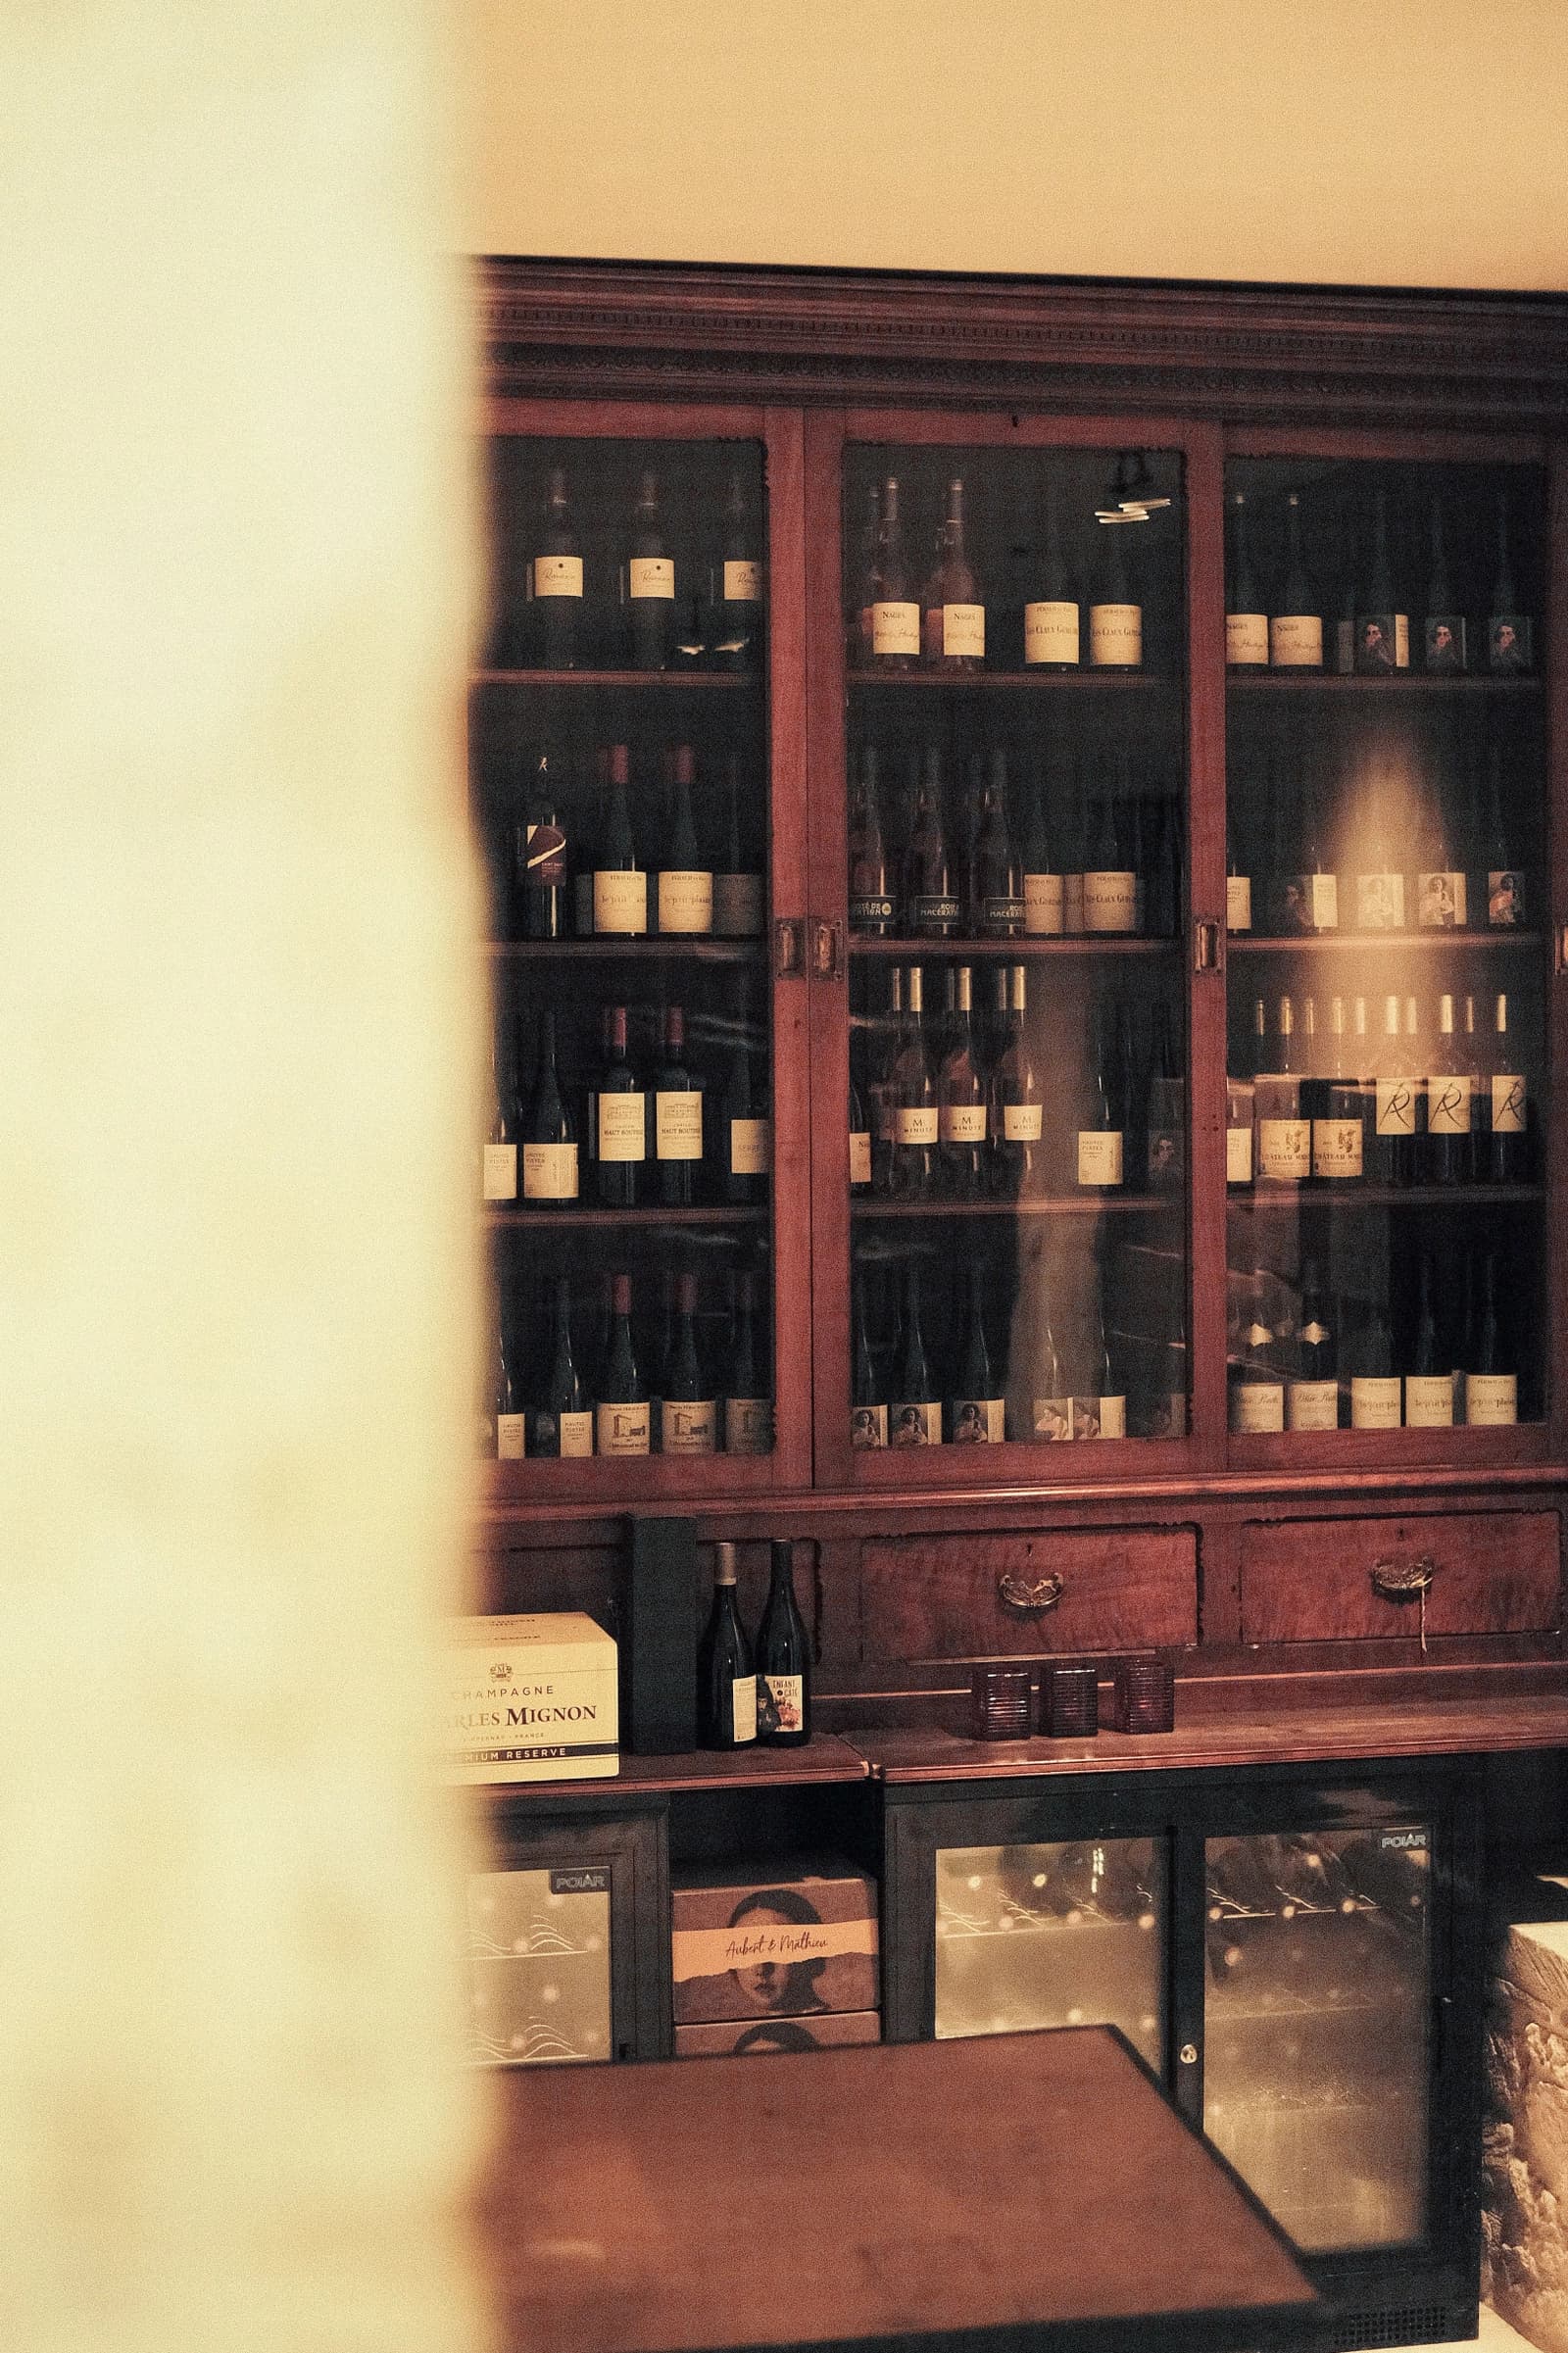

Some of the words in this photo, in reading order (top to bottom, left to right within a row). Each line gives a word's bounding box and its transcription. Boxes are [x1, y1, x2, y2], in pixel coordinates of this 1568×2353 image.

[505, 1704, 598, 1727] MIGNON
[507, 1747, 566, 1760] RESERVE
[1381, 1833, 1427, 1849] POLAR
[556, 1873, 606, 1889] POLAR
[725, 1935, 765, 1958] Aubert
[779, 1932, 829, 1953] Mathieu
